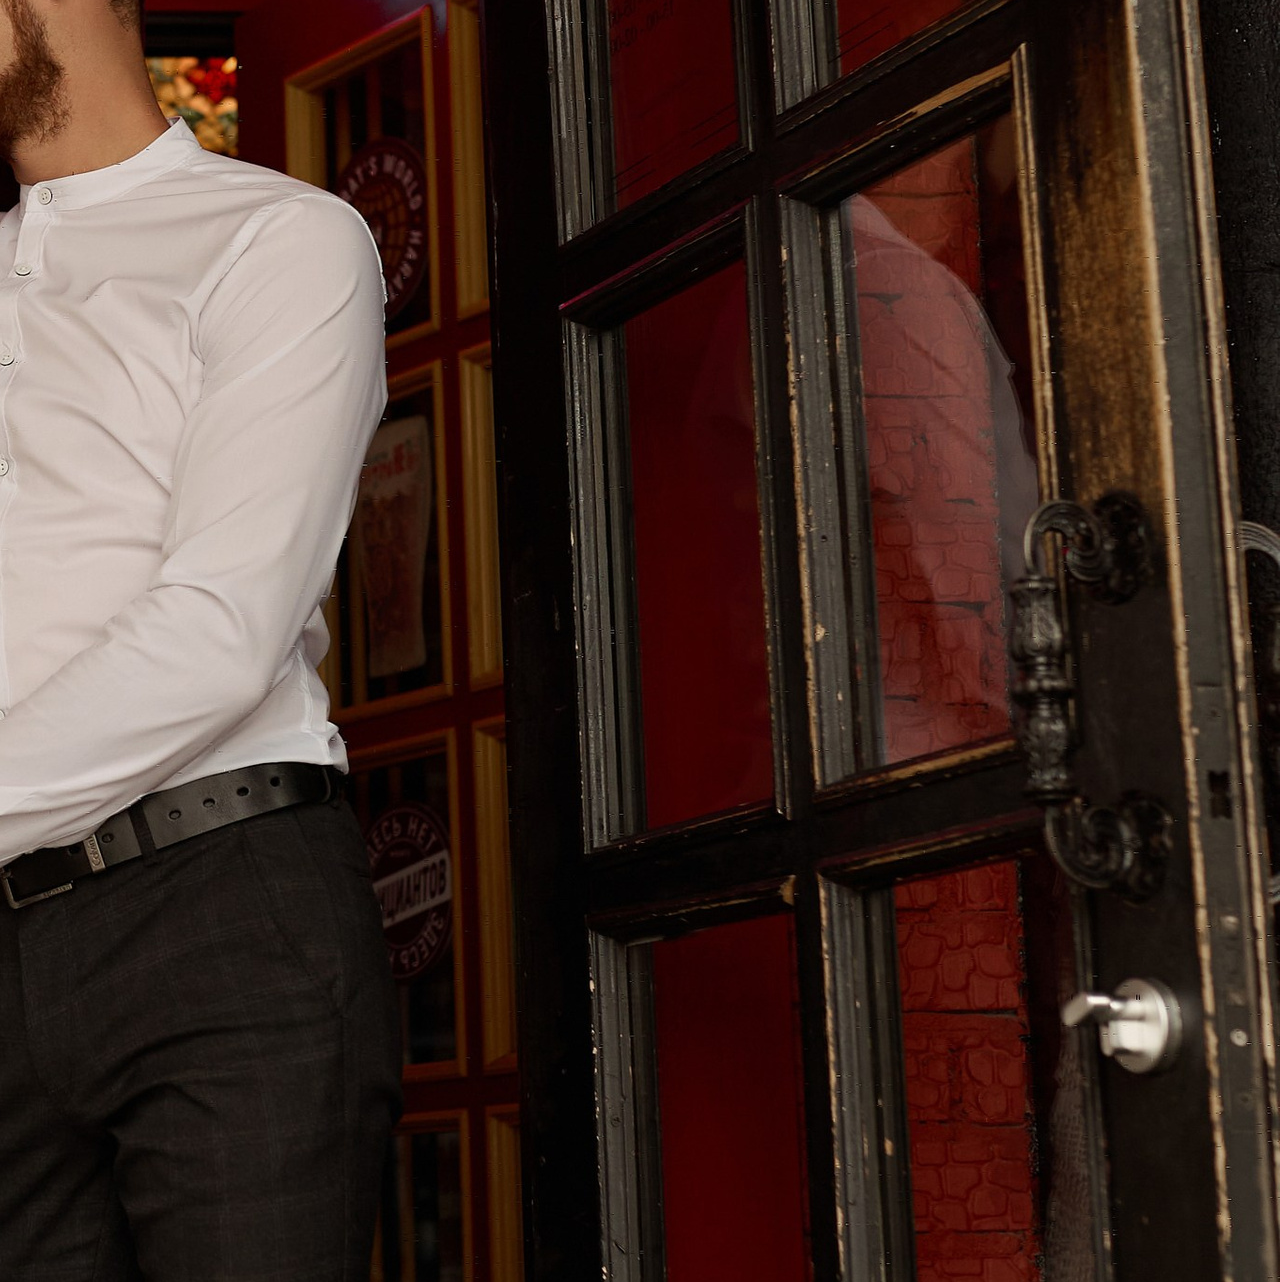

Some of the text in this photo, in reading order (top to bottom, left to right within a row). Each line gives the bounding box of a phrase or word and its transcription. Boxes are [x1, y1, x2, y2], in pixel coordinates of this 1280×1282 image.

[382, 153, 423, 211] WORLD
[367, 816, 438, 866] ДЕСЬ НЕТ
[377, 858, 446, 921] ЦИАНТОВ
[399, 911, 445, 970] ЗДЕСЬ
